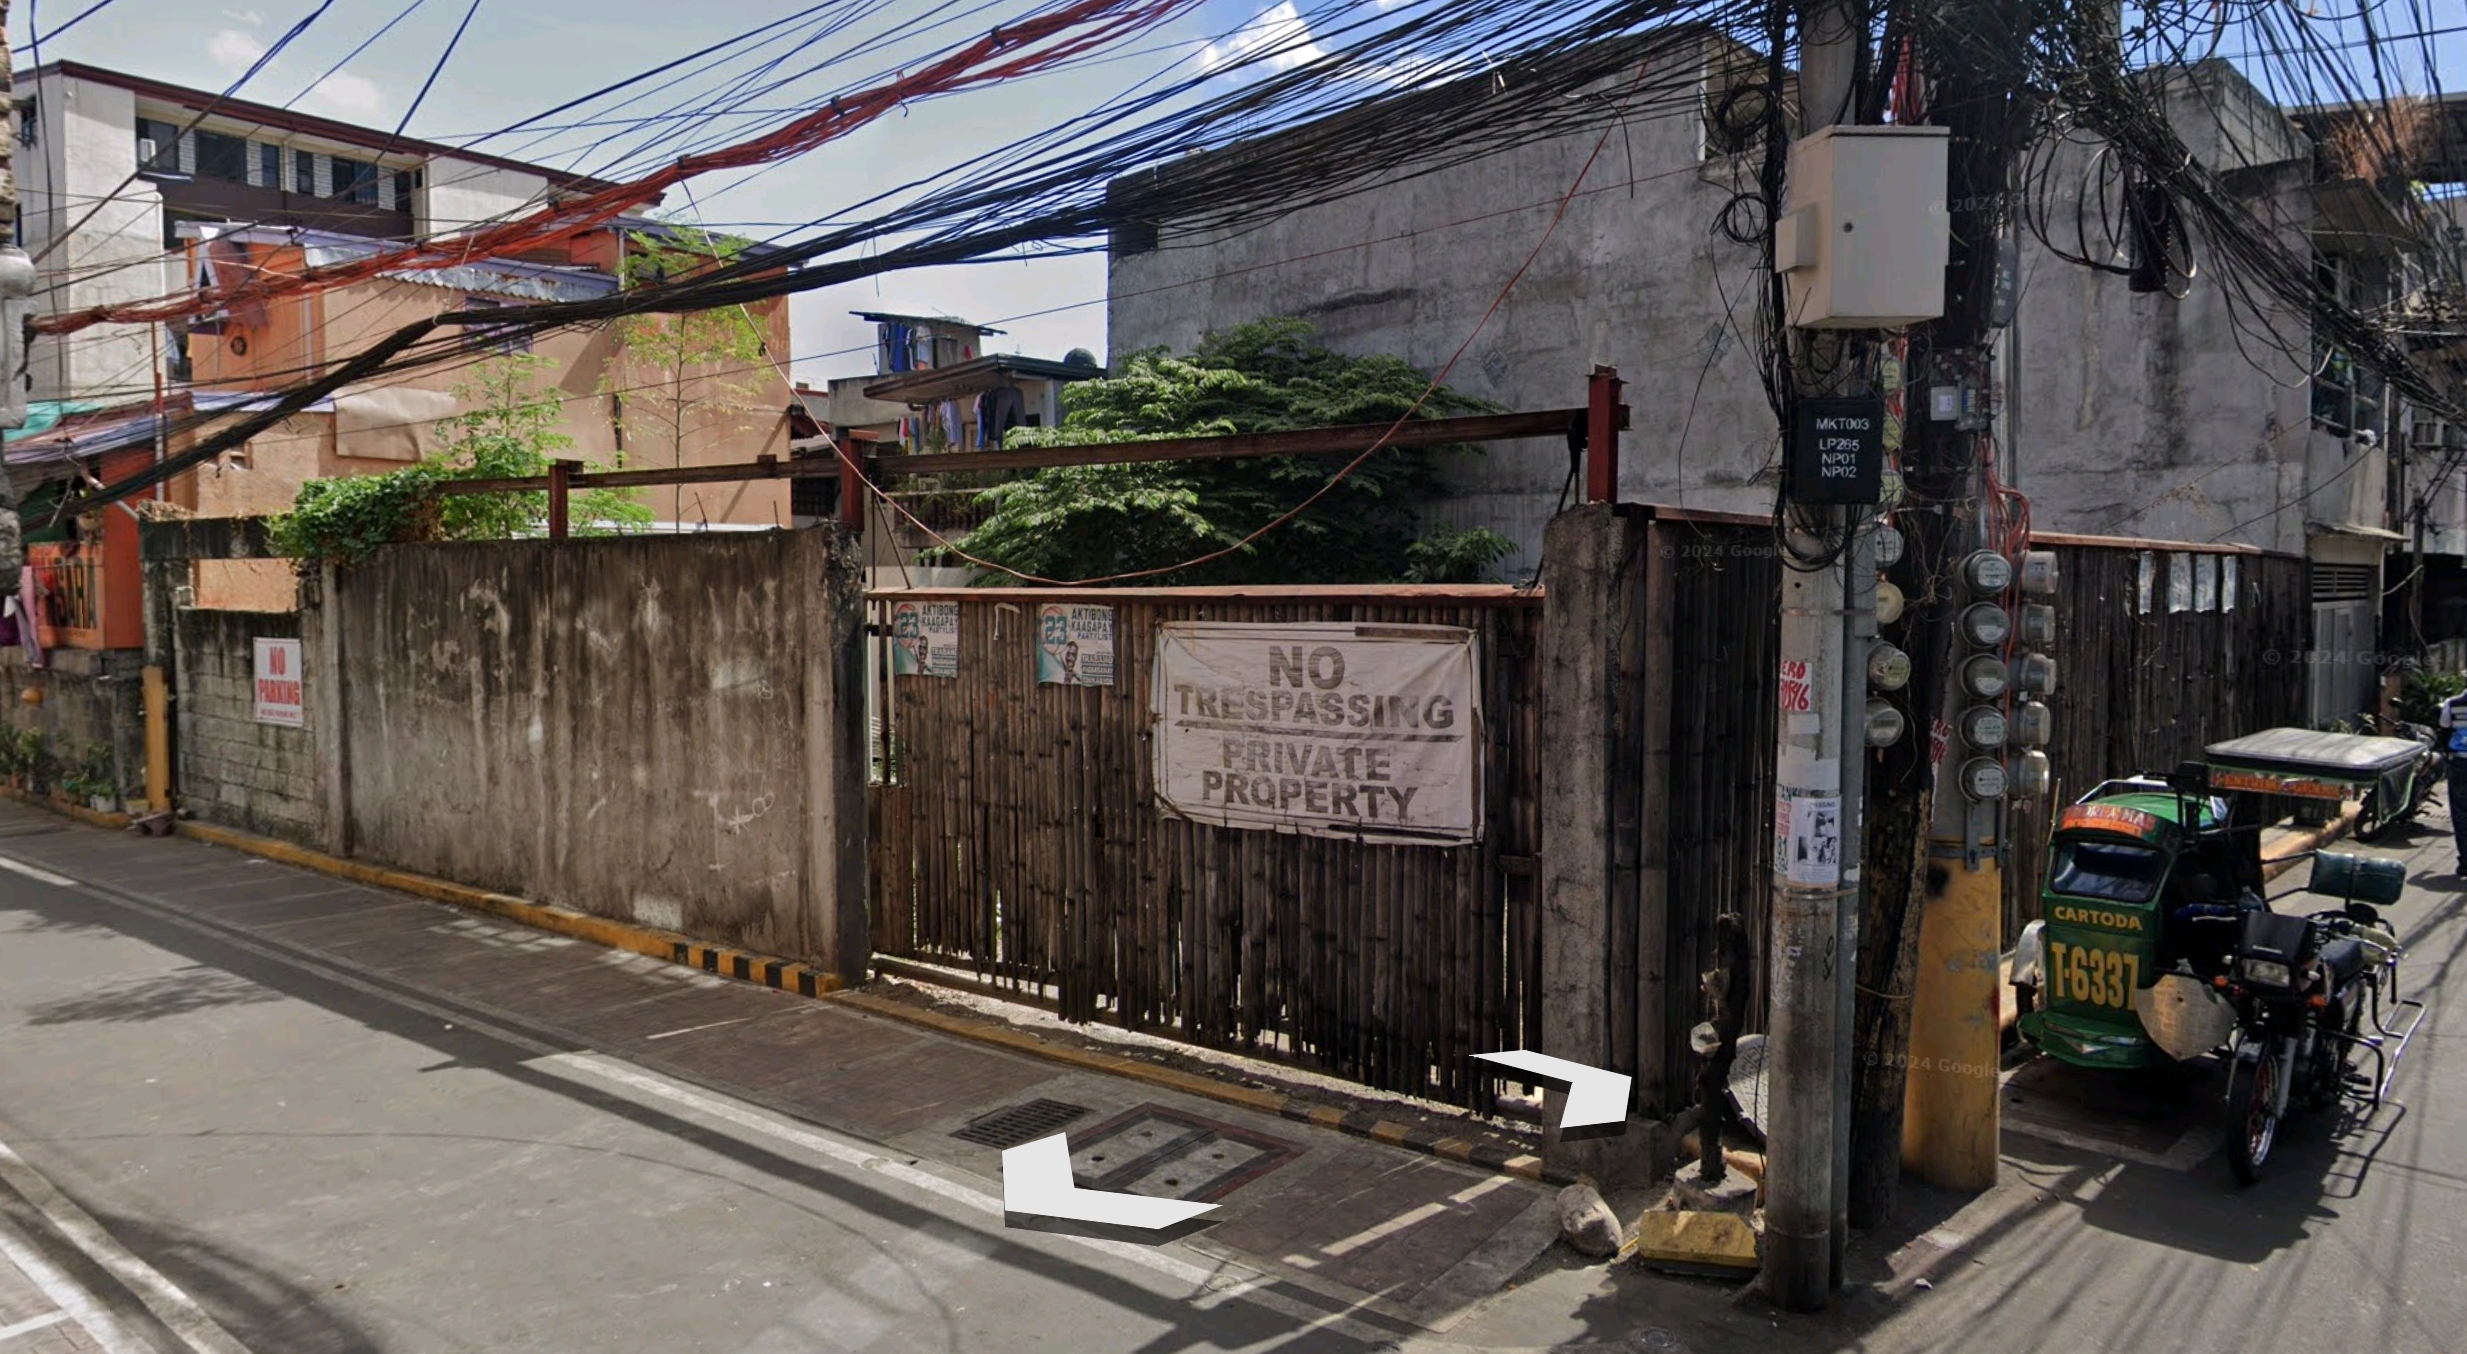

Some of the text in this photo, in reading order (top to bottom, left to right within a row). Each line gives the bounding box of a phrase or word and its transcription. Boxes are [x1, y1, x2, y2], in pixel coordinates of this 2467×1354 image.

[1816, 418, 1870, 430] MKT003
[1819, 438, 1860, 451] LP265
[1821, 453, 1856, 464] NP01
[1821, 466, 1857, 478] NP02
[899, 612, 919, 638] 23
[1071, 608, 1112, 621] AKTIBONG
[1044, 615, 1067, 645] 23
[269, 647, 286, 675] NO
[1269, 645, 1345, 690] NO
[258, 678, 300, 705] PARKING
[1173, 684, 1454, 730] TRESPASSING
[1222, 731, 1391, 781] PRIVATE
[1202, 770, 1419, 820] PROPERTY
[2054, 905, 2143, 931] CARTODA
[2051, 942, 2139, 1012] T-6337
